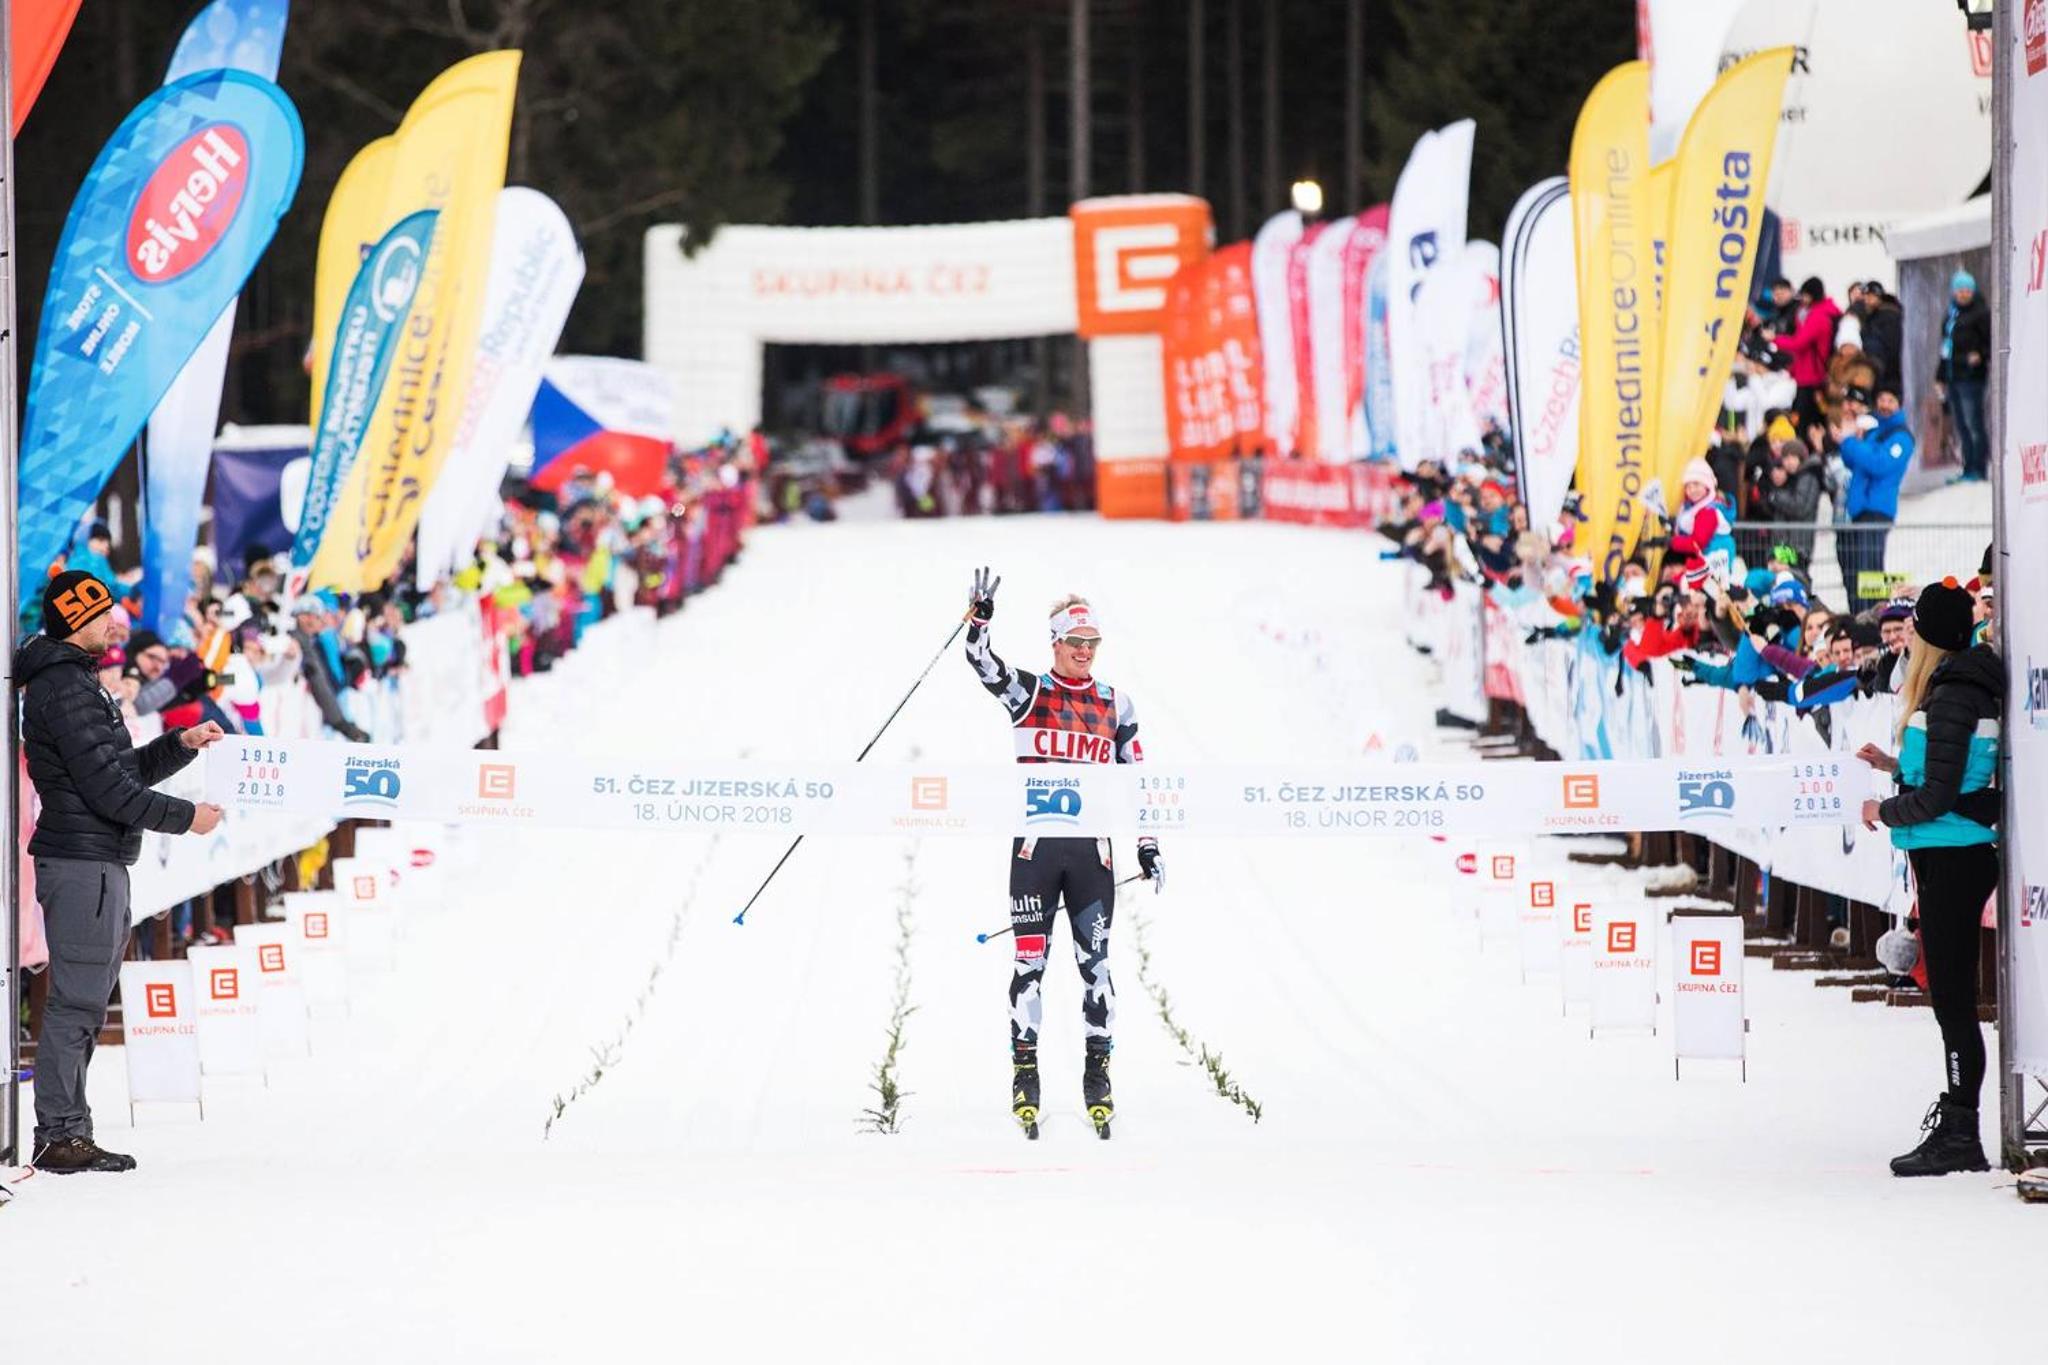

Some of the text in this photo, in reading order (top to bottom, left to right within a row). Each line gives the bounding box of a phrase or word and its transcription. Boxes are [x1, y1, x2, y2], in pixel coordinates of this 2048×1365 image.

[53, 577, 110, 622] 50
[1034, 729, 1112, 765] CLIMB
[240, 748, 288, 764] 1918
[344, 756, 401, 769] Jizerská
[245, 765, 280, 781] 100
[1676, 769, 1734, 782] Jizerská
[1793, 764, 1839, 778] 1918
[237, 781, 285, 798] 2018
[344, 768, 401, 800] 50
[592, 774, 834, 799] 51. ČEZ JIZERSKÁ 50
[1025, 776, 1081, 788] Jizerská
[1139, 777, 1185, 790] 1918
[1800, 781, 1834, 794] 100
[1244, 781, 1485, 803] 51. ČEZ JIZERSKÁ 50
[1679, 781, 1735, 812] 50
[1026, 788, 1082, 817] 50
[1794, 797, 1841, 812] 2018
[457, 805, 510, 817] SKUPINA
[633, 800, 793, 824] 18. ÚNOR 2018
[1139, 808, 1185, 821] 2018
[1285, 806, 1445, 828] 18. ÚNOR 2018
[1544, 815, 1596, 827] SKUPINA
[1594, 959, 1632, 970] SKUPINA
[1677, 980, 1738, 993] SKUPINA ČEZ
[131, 1025, 176, 1036] SKUPINA
